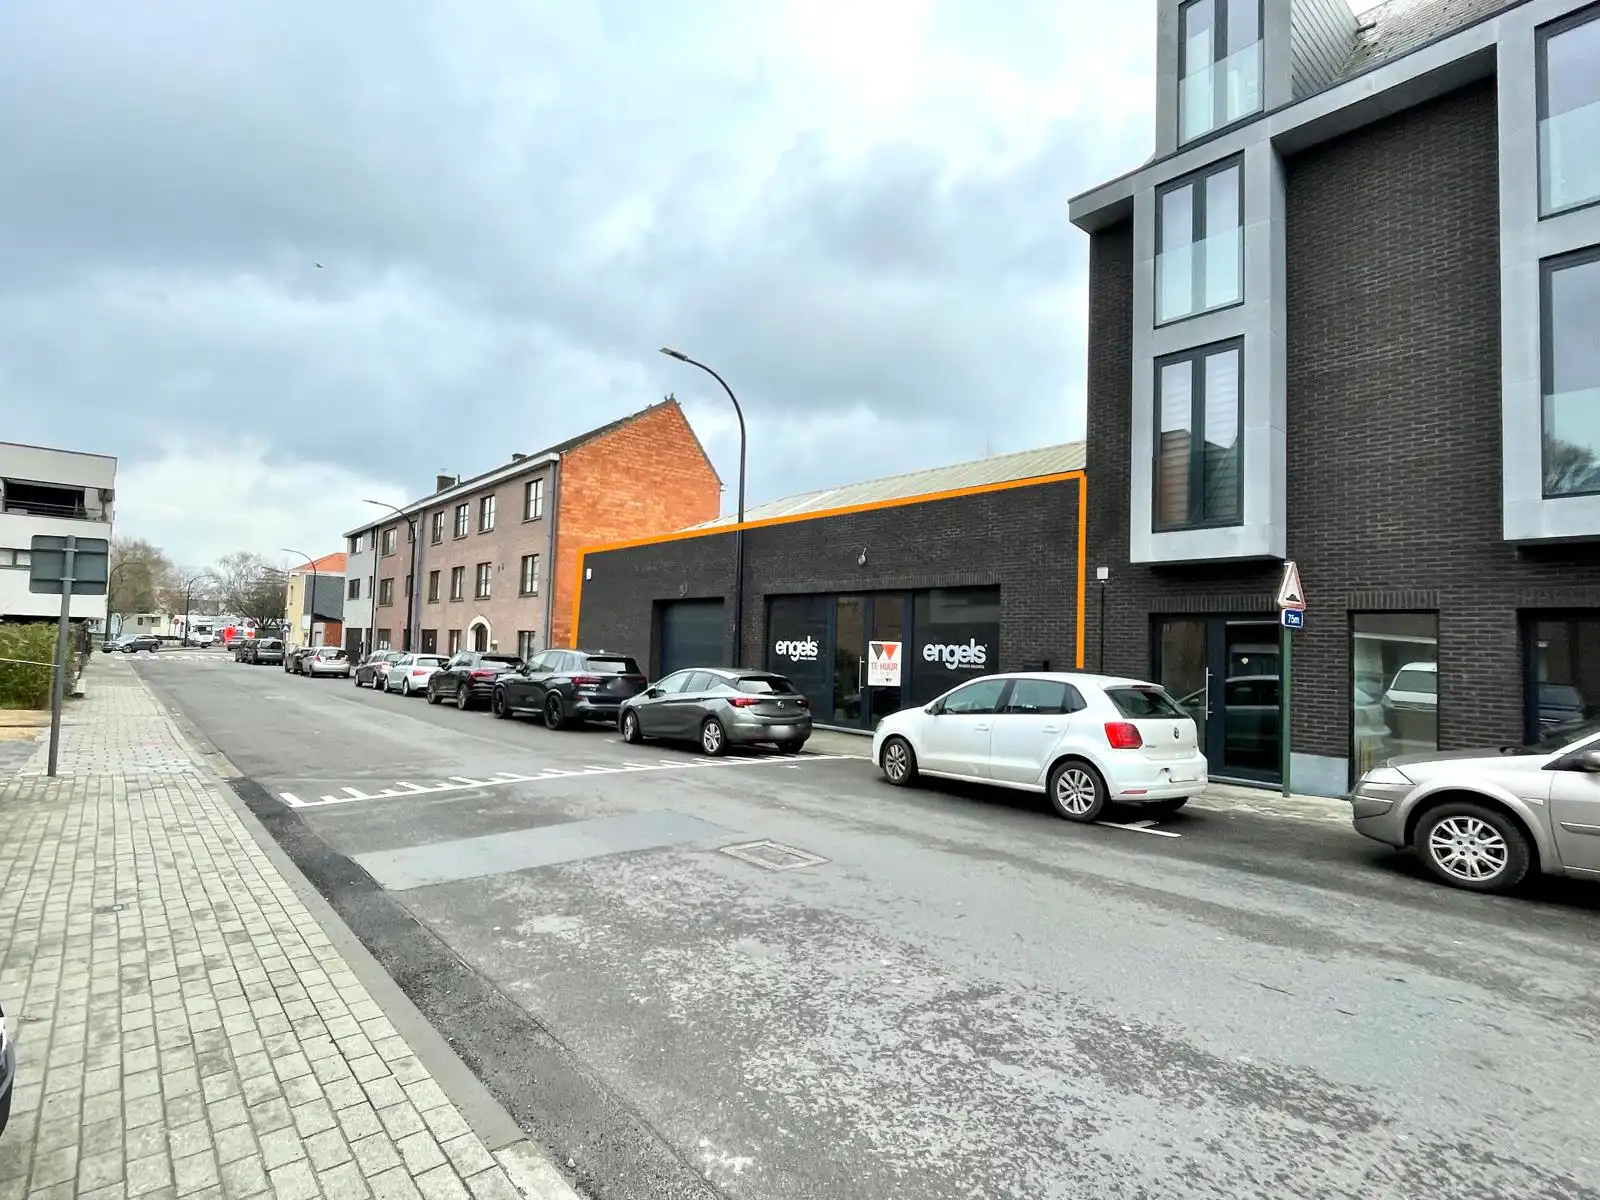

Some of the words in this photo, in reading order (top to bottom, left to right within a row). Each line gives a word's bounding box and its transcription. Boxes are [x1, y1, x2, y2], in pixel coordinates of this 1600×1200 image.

[1288, 614, 1299, 624] 75m
[775, 636, 818, 661] engels
[922, 638, 986, 669] engels
[871, 662, 879, 671] TE
[879, 662, 898, 672] HUUR
